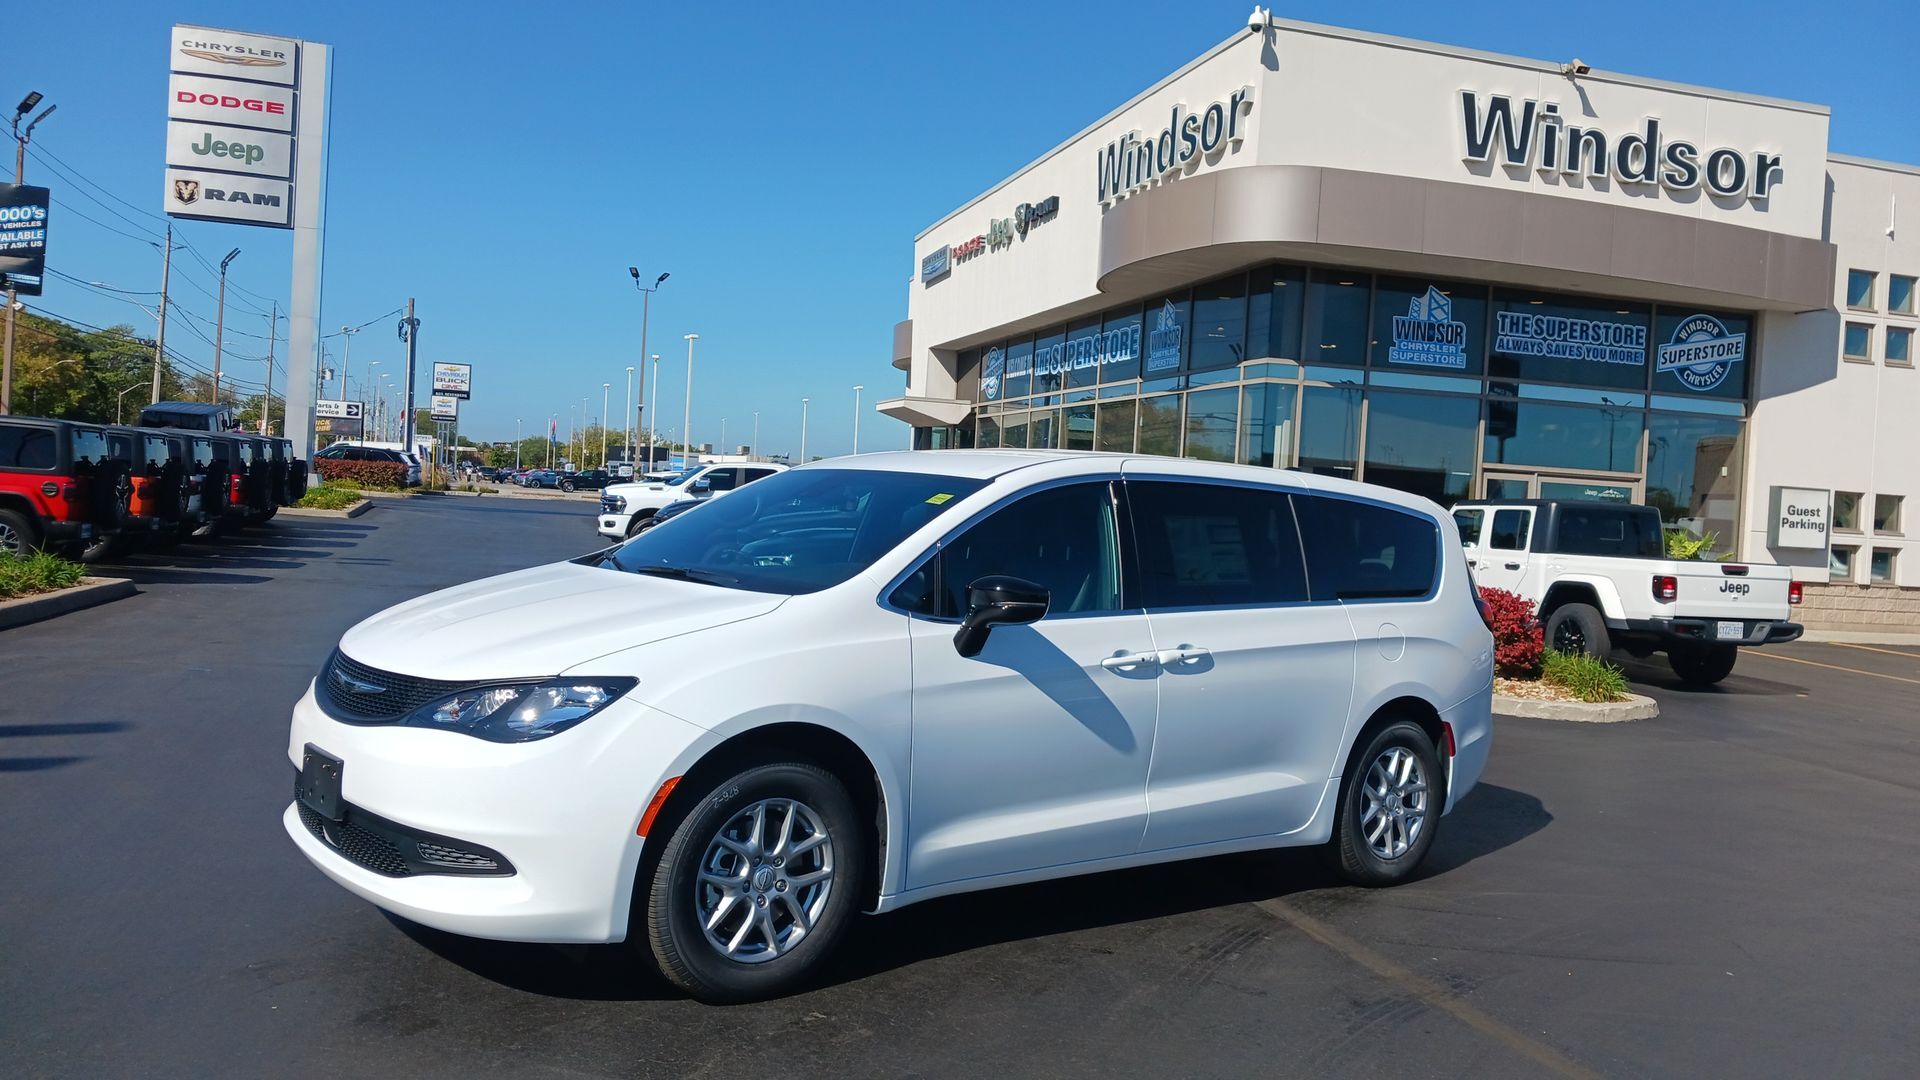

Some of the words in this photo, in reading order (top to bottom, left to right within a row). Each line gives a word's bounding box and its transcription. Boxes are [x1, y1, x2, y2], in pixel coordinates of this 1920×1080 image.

[182, 40, 286, 59] CHRYSLER
[177, 91, 285, 114] DODGE
[191, 132, 264, 166] Jeep
[1097, 85, 1255, 205] Windsor
[1460, 89, 1784, 199] Windsor
[204, 188, 281, 208] RAM
[3, 221, 42, 229] VEHICLES
[1395, 319, 1464, 345] WINDSOR
[1498, 313, 1532, 336] THE
[1533, 317, 1645, 347] SUPERSTORE
[1679, 320, 1720, 340] WINDSOR
[1035, 348, 1050, 376] THE
[1051, 325, 1141, 375] SUPERSTORE
[1392, 350, 1464, 365] SUPERSTORE
[1400, 341, 1457, 353] CHRYSLER
[1497, 338, 1544, 355] ALWAYS
[1545, 342, 1583, 358] SAVES
[1584, 345, 1608, 360] YOU
[1609, 348, 1644, 365] MORE!
[1661, 342, 1741, 365] SUPERSTORE
[436, 377, 468, 385] BUICK
[1683, 364, 1724, 386] CHRYSLER
[1787, 504, 1821, 517] Guest
[1781, 517, 1825, 533] Parking
[1719, 580, 1750, 596] Jeep
